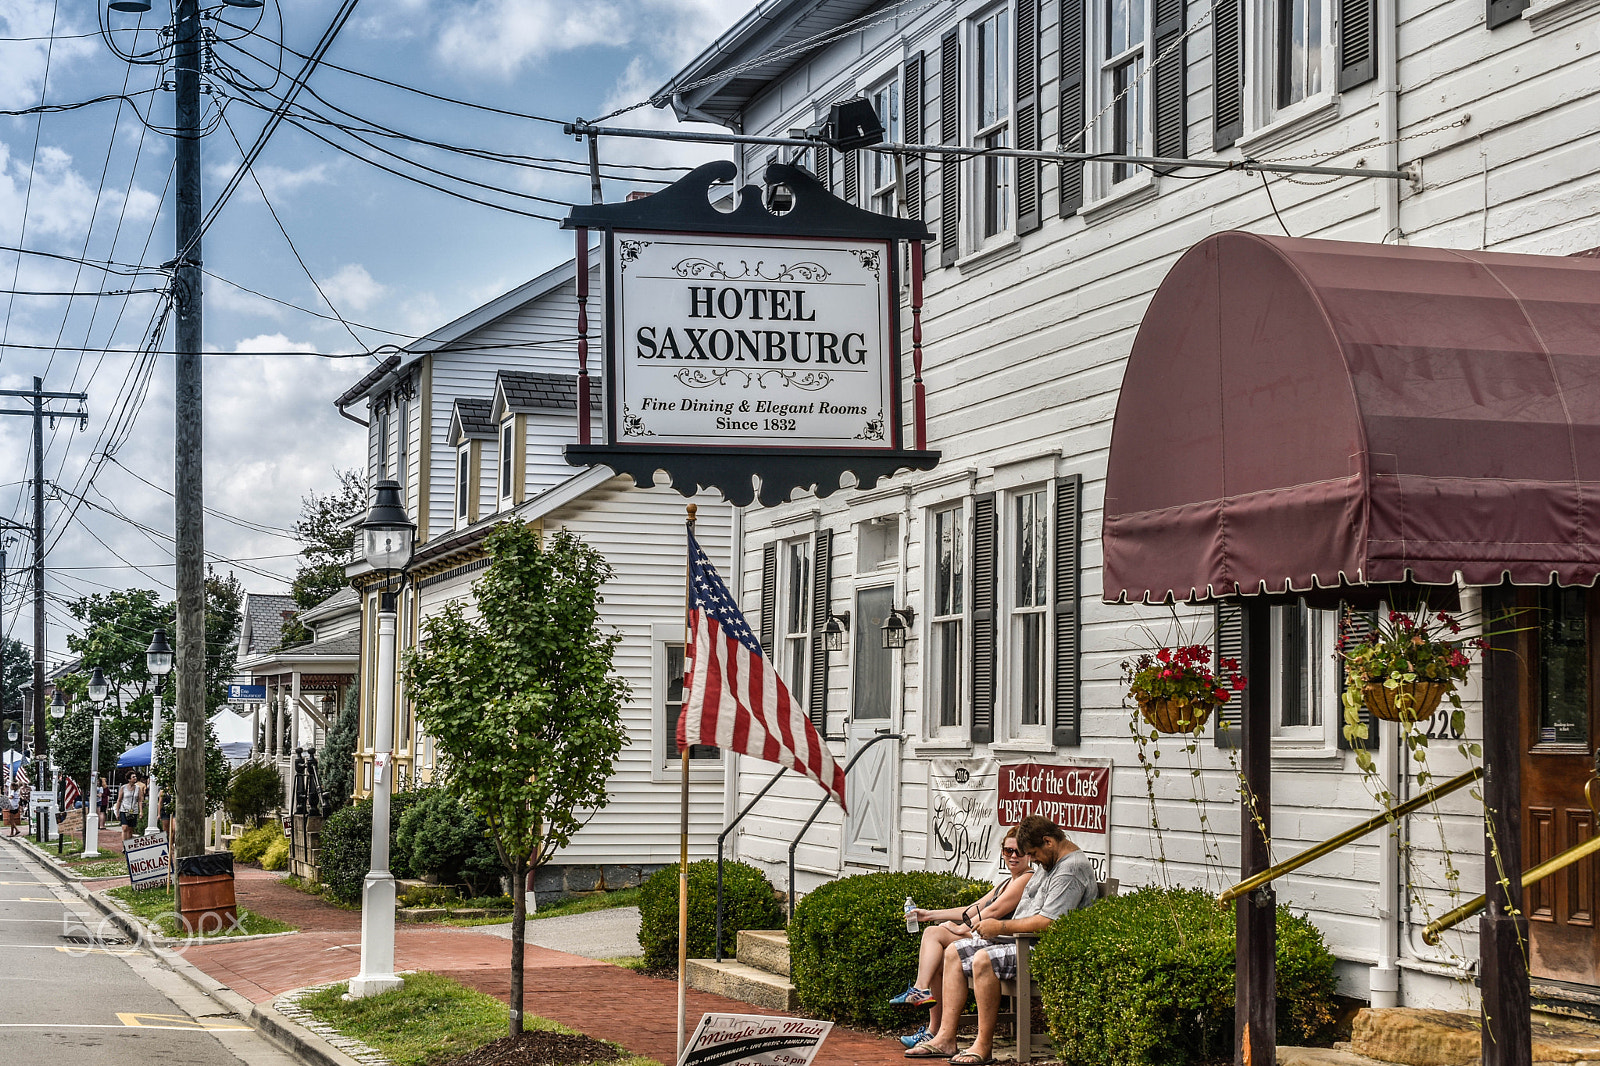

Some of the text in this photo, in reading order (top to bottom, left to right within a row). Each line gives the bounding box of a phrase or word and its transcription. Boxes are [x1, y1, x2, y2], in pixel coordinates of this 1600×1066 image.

[688, 286, 816, 322] HOTEL
[636, 327, 868, 365] SAXONBURG
[641, 397, 868, 417] Fine Dining & Elegant Rooms
[716, 417, 797, 432] Since 1832
[1009, 768, 1098, 797] Best of the Chefs
[128, 837, 164, 850] PENDING
[134, 835, 157, 844] SALE
[130, 855, 169, 874] NICKLAS
[700, 1022, 824, 1046] Mingle on Main
[773, 1055, 807, 1065] 5-8 pm
